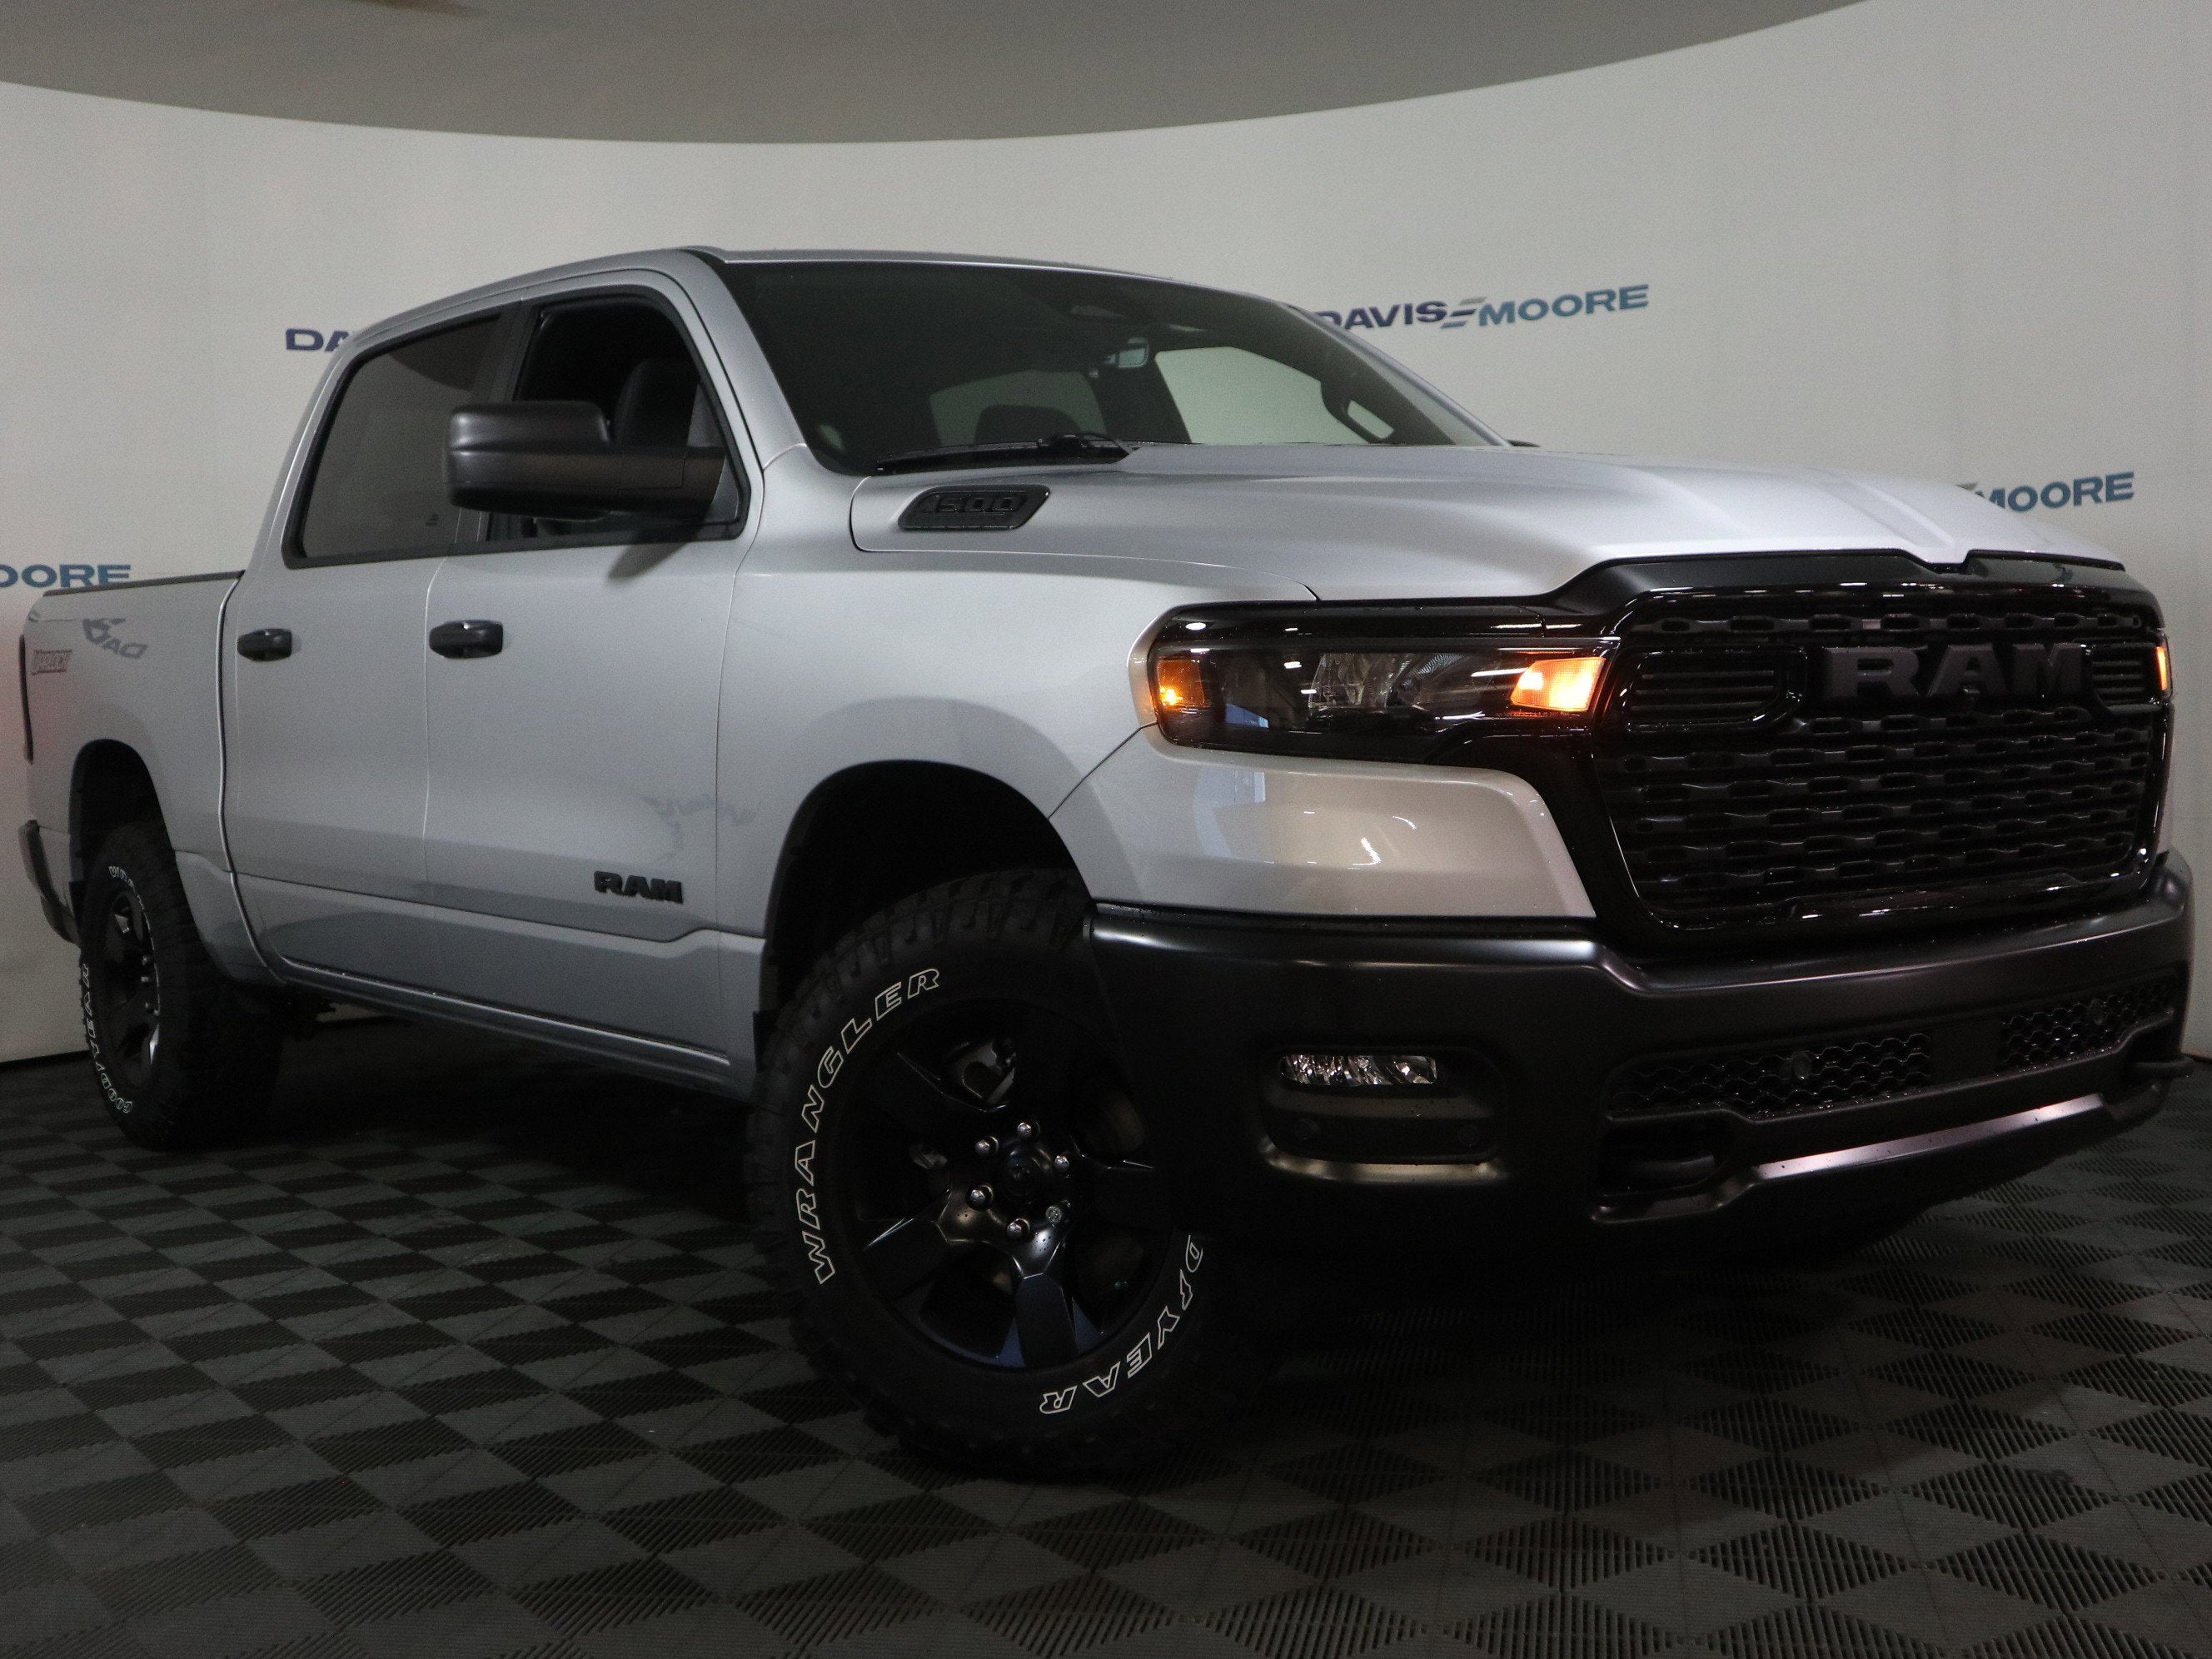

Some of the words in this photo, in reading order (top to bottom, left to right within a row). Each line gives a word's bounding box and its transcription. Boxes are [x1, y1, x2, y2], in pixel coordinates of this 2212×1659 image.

[1478, 283, 1649, 326] MOORE
[1822, 642, 2084, 698] RAM
[594, 870, 683, 904] RAM
[795, 968, 940, 1285] WRANGLER
